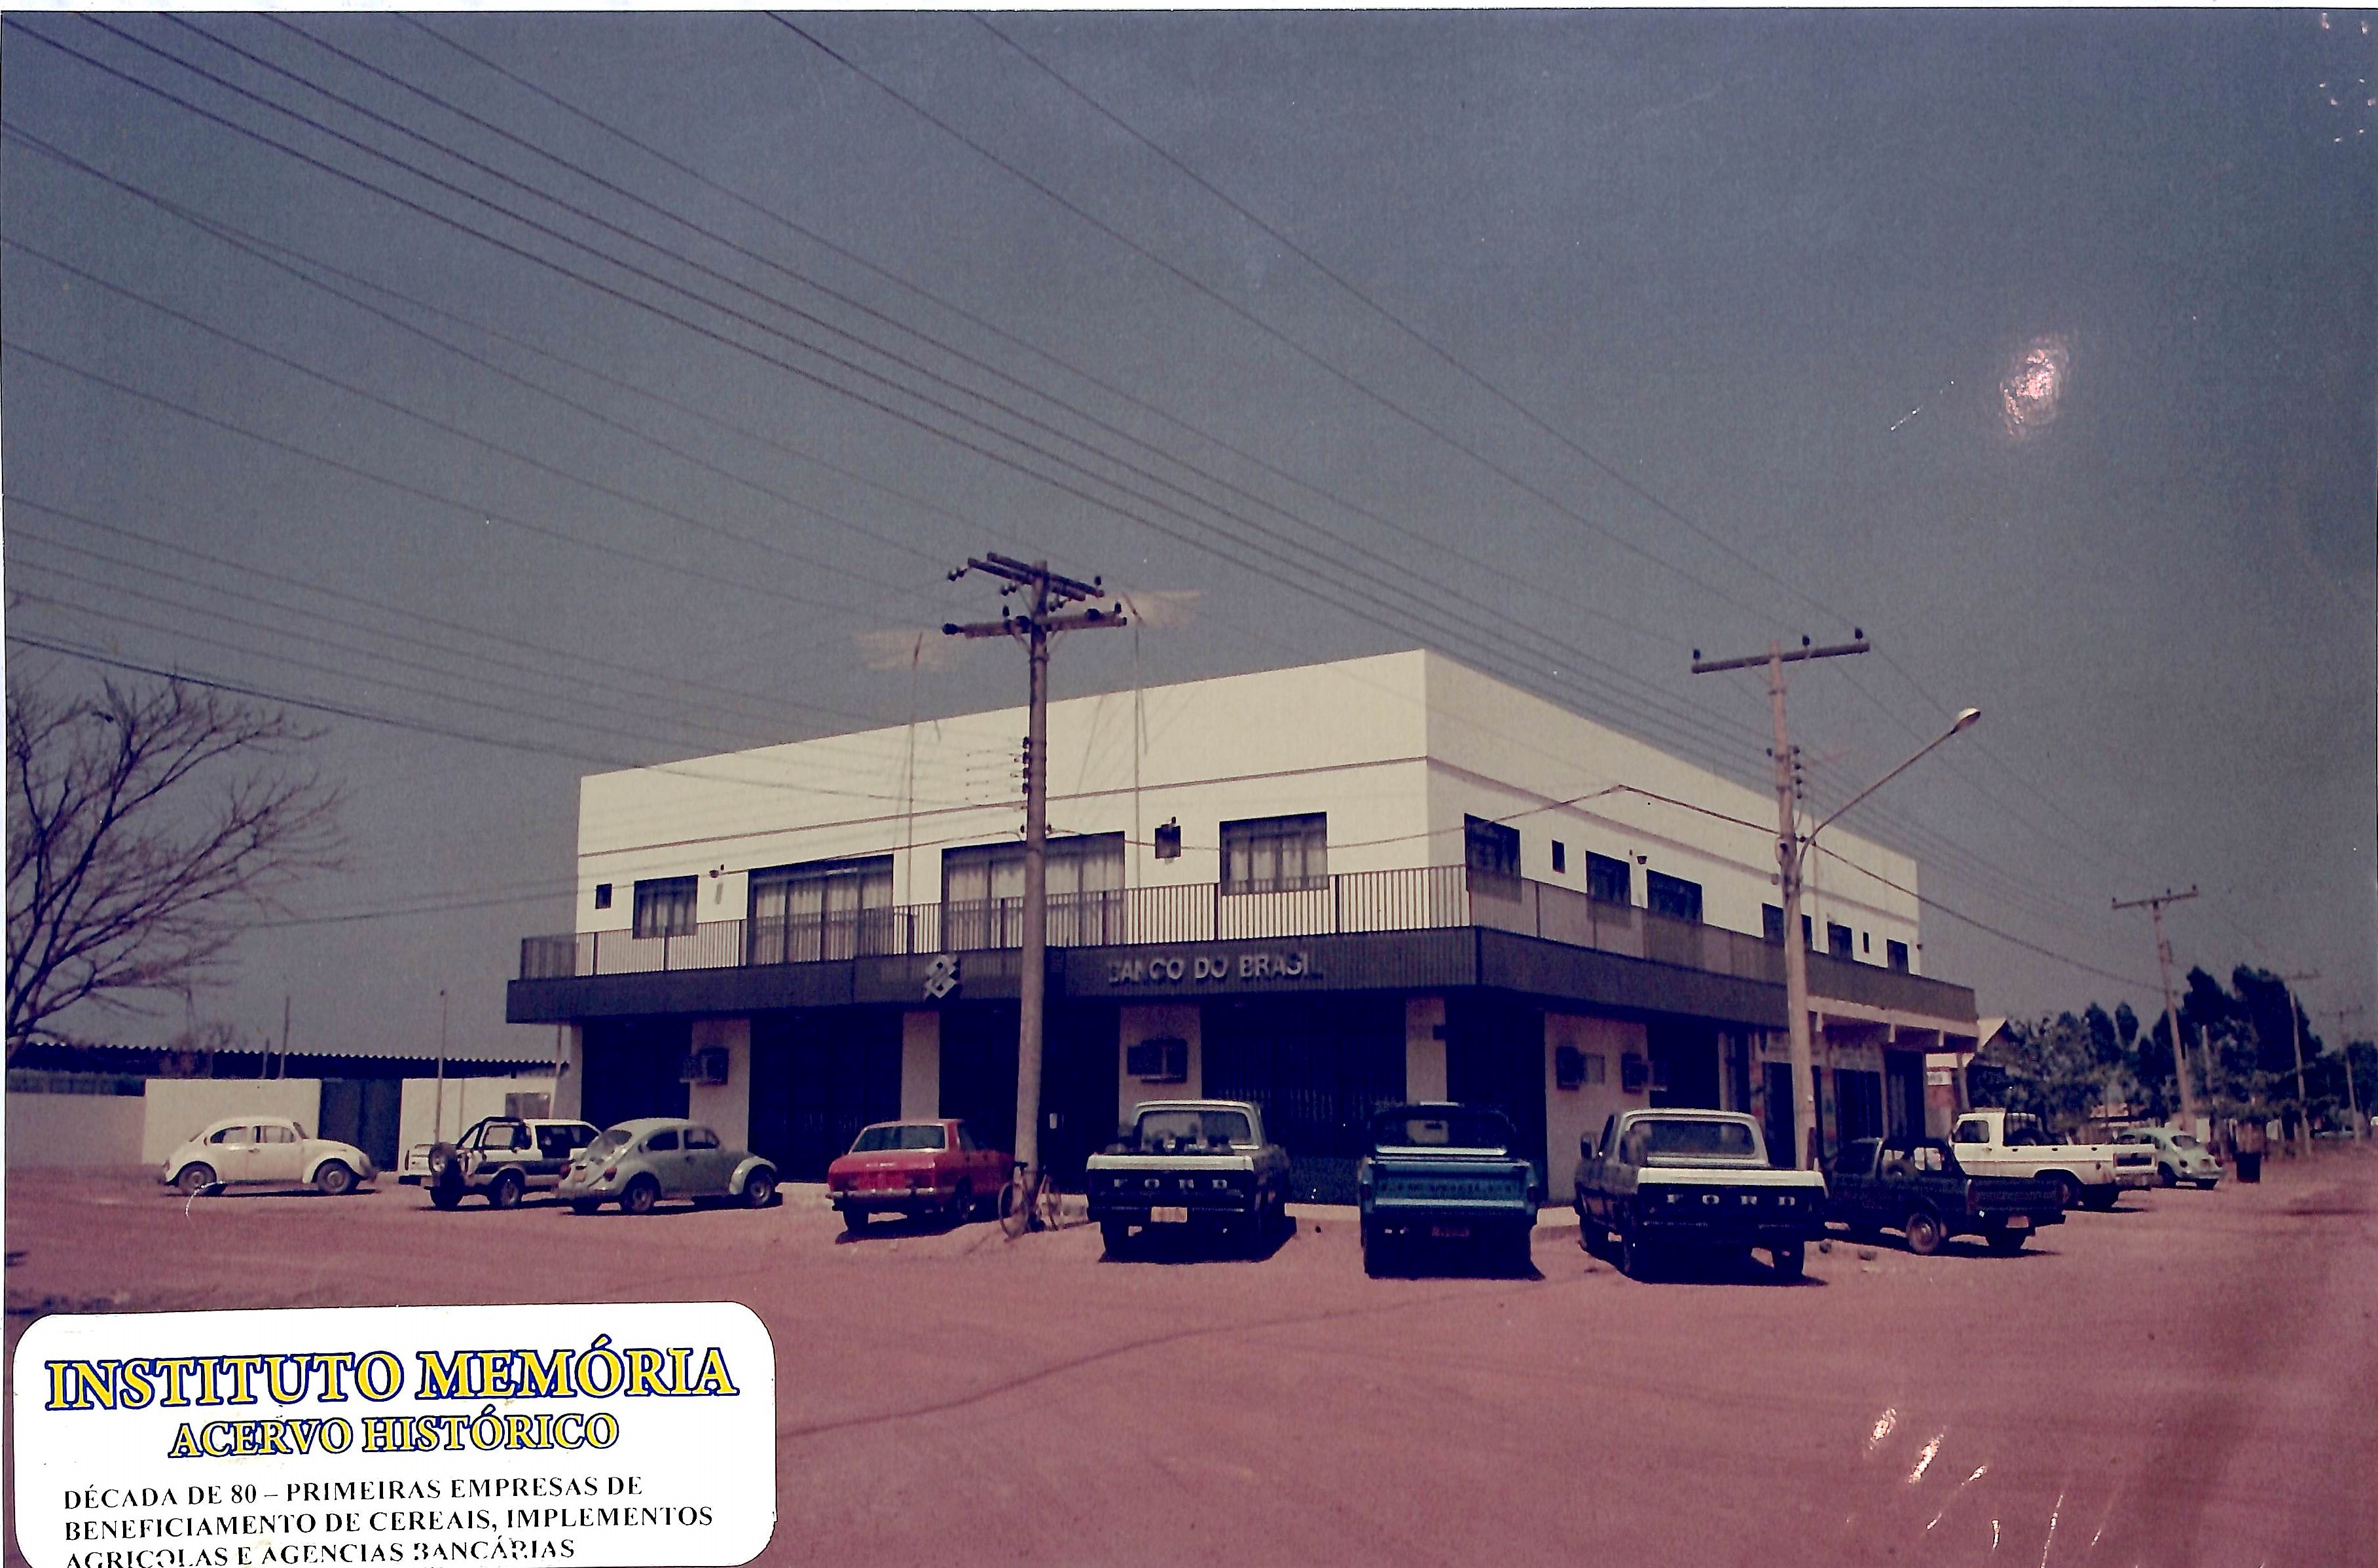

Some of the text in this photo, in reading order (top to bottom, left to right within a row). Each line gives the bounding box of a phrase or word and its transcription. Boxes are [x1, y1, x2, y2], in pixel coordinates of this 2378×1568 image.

[1194, 956, 1228, 978] DO
[1114, 1178, 1228, 1189] FORD
[1667, 1194, 1795, 1206] FORD
